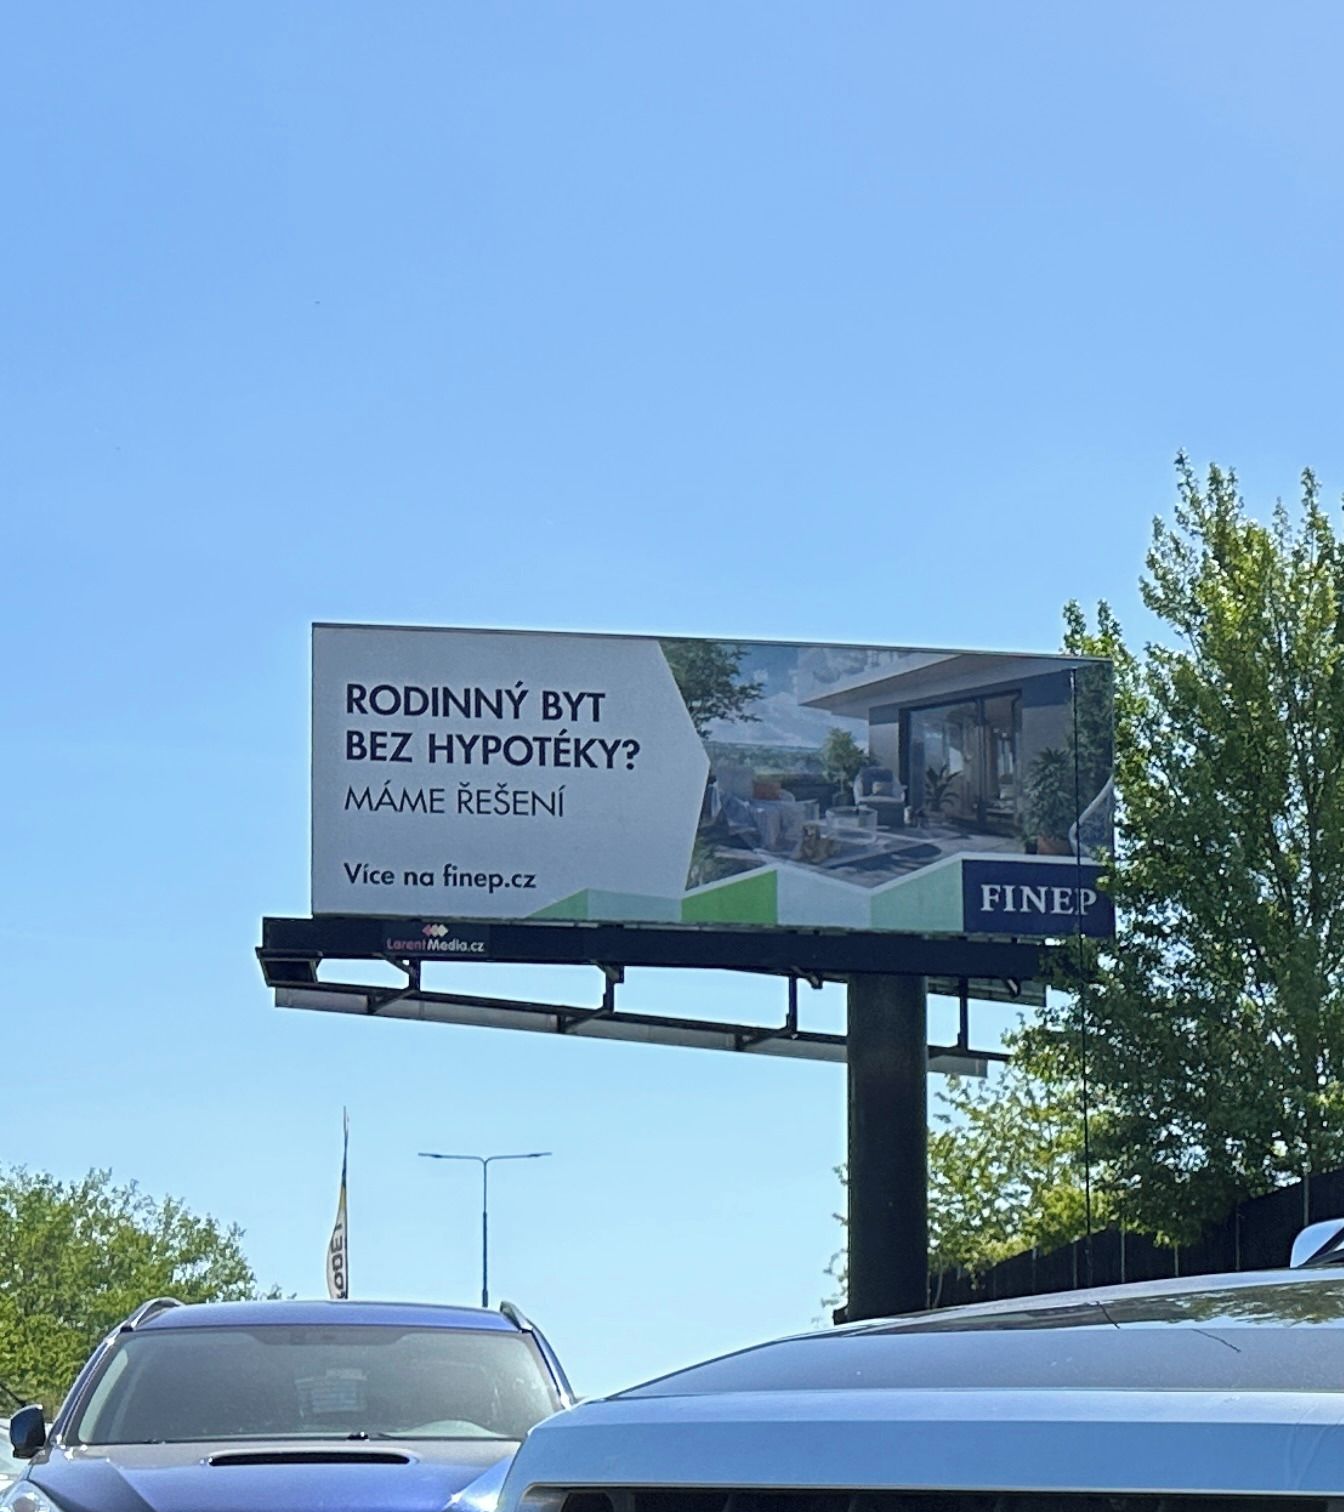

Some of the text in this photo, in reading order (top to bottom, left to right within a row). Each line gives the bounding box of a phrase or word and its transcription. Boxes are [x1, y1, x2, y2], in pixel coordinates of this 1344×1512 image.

[345, 680, 606, 724] RODINNÝ BYT
[346, 729, 640, 771] BEZ HYPOTÉKY?
[344, 779, 566, 818] MÁME ŘEŠENÍ
[344, 862, 537, 893] Více na finep.cz
[980, 884, 1097, 915] FINEP
